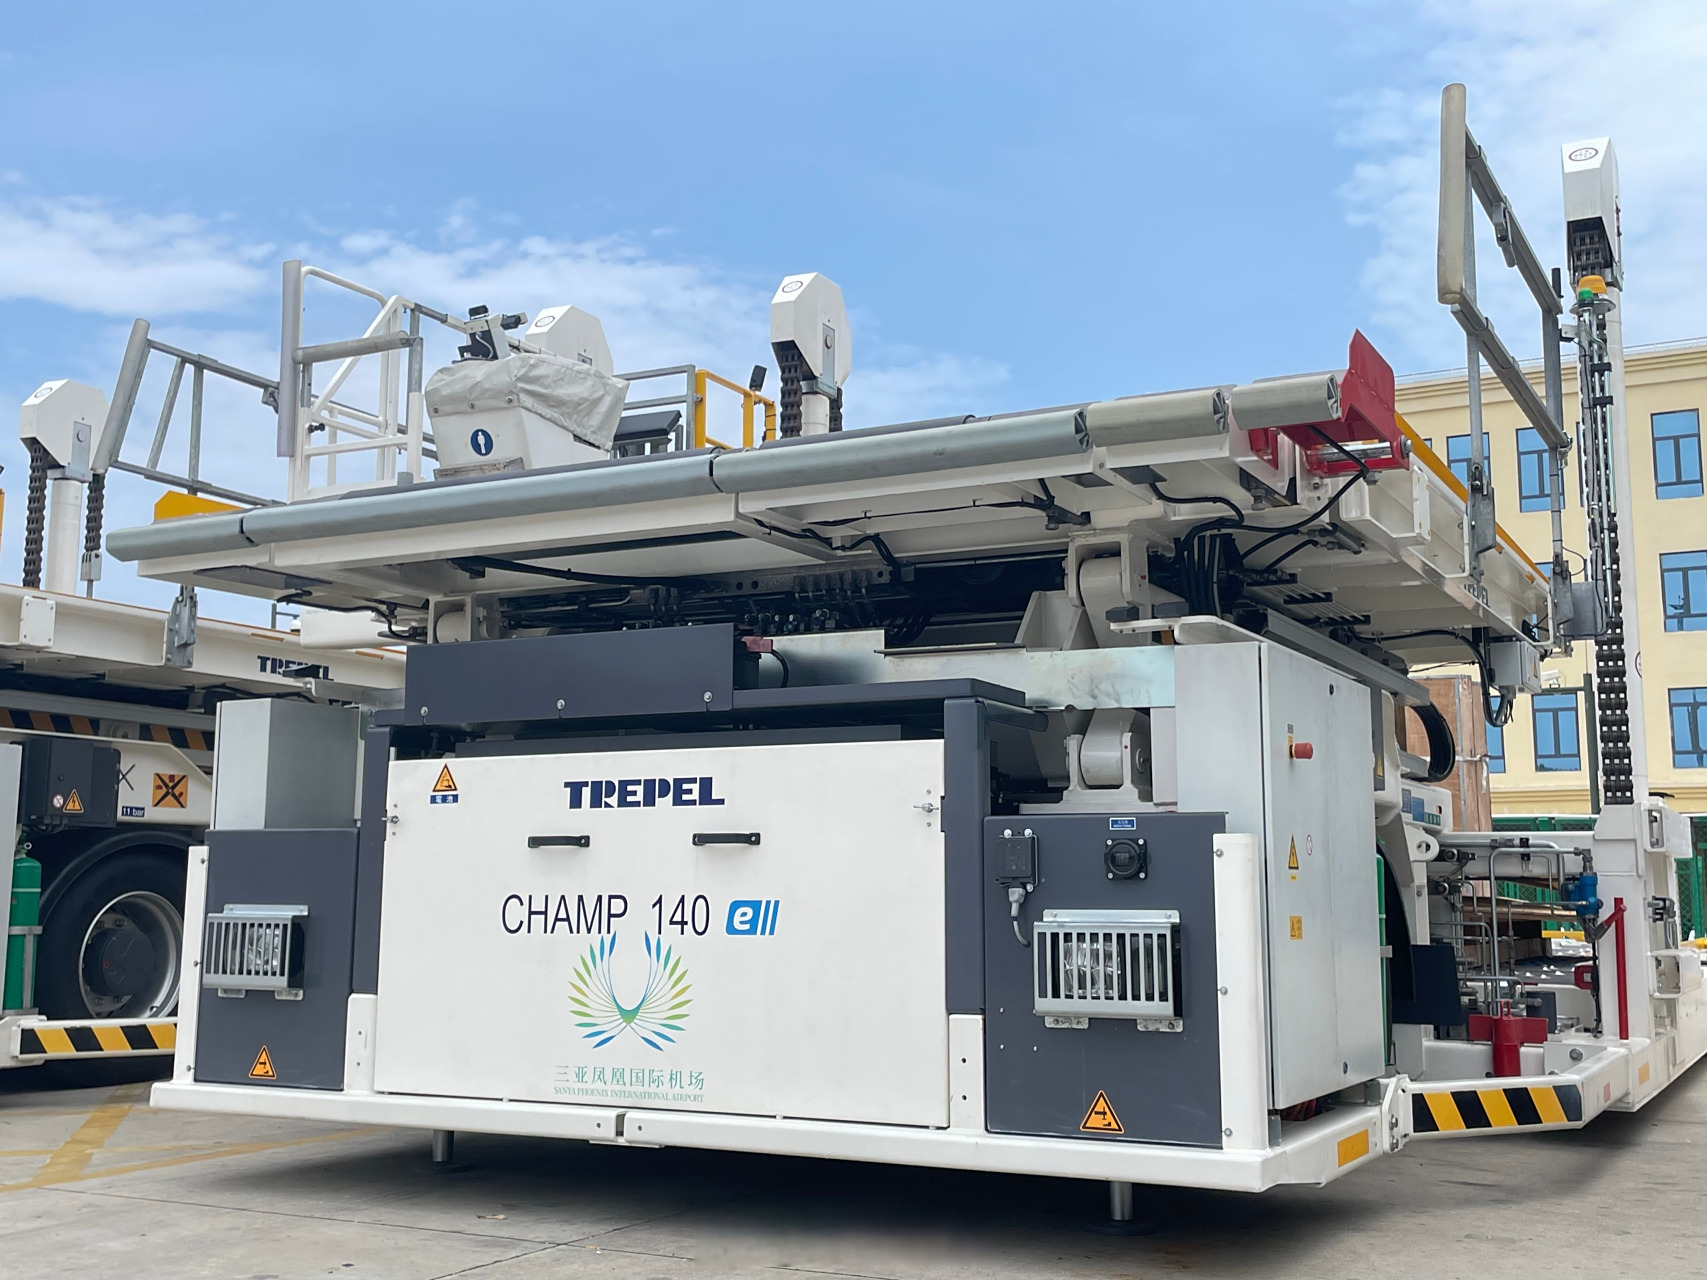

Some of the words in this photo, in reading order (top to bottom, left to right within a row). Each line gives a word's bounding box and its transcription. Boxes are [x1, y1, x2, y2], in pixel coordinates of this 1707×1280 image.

[257, 655, 334, 681] TREL
[563, 776, 726, 810] TREPEL
[132, 808, 145, 816] bar
[501, 894, 629, 935] CHAMP
[651, 894, 710, 936] 140
[554, 1065, 705, 1091] 三亚凤凰国际机场
[554, 1086, 576, 1095] SANYA
[577, 1088, 609, 1097] PHOENIX
[610, 1089, 670, 1100] INTERNATIONAL
[672, 1093, 704, 1103] AIRPORT
